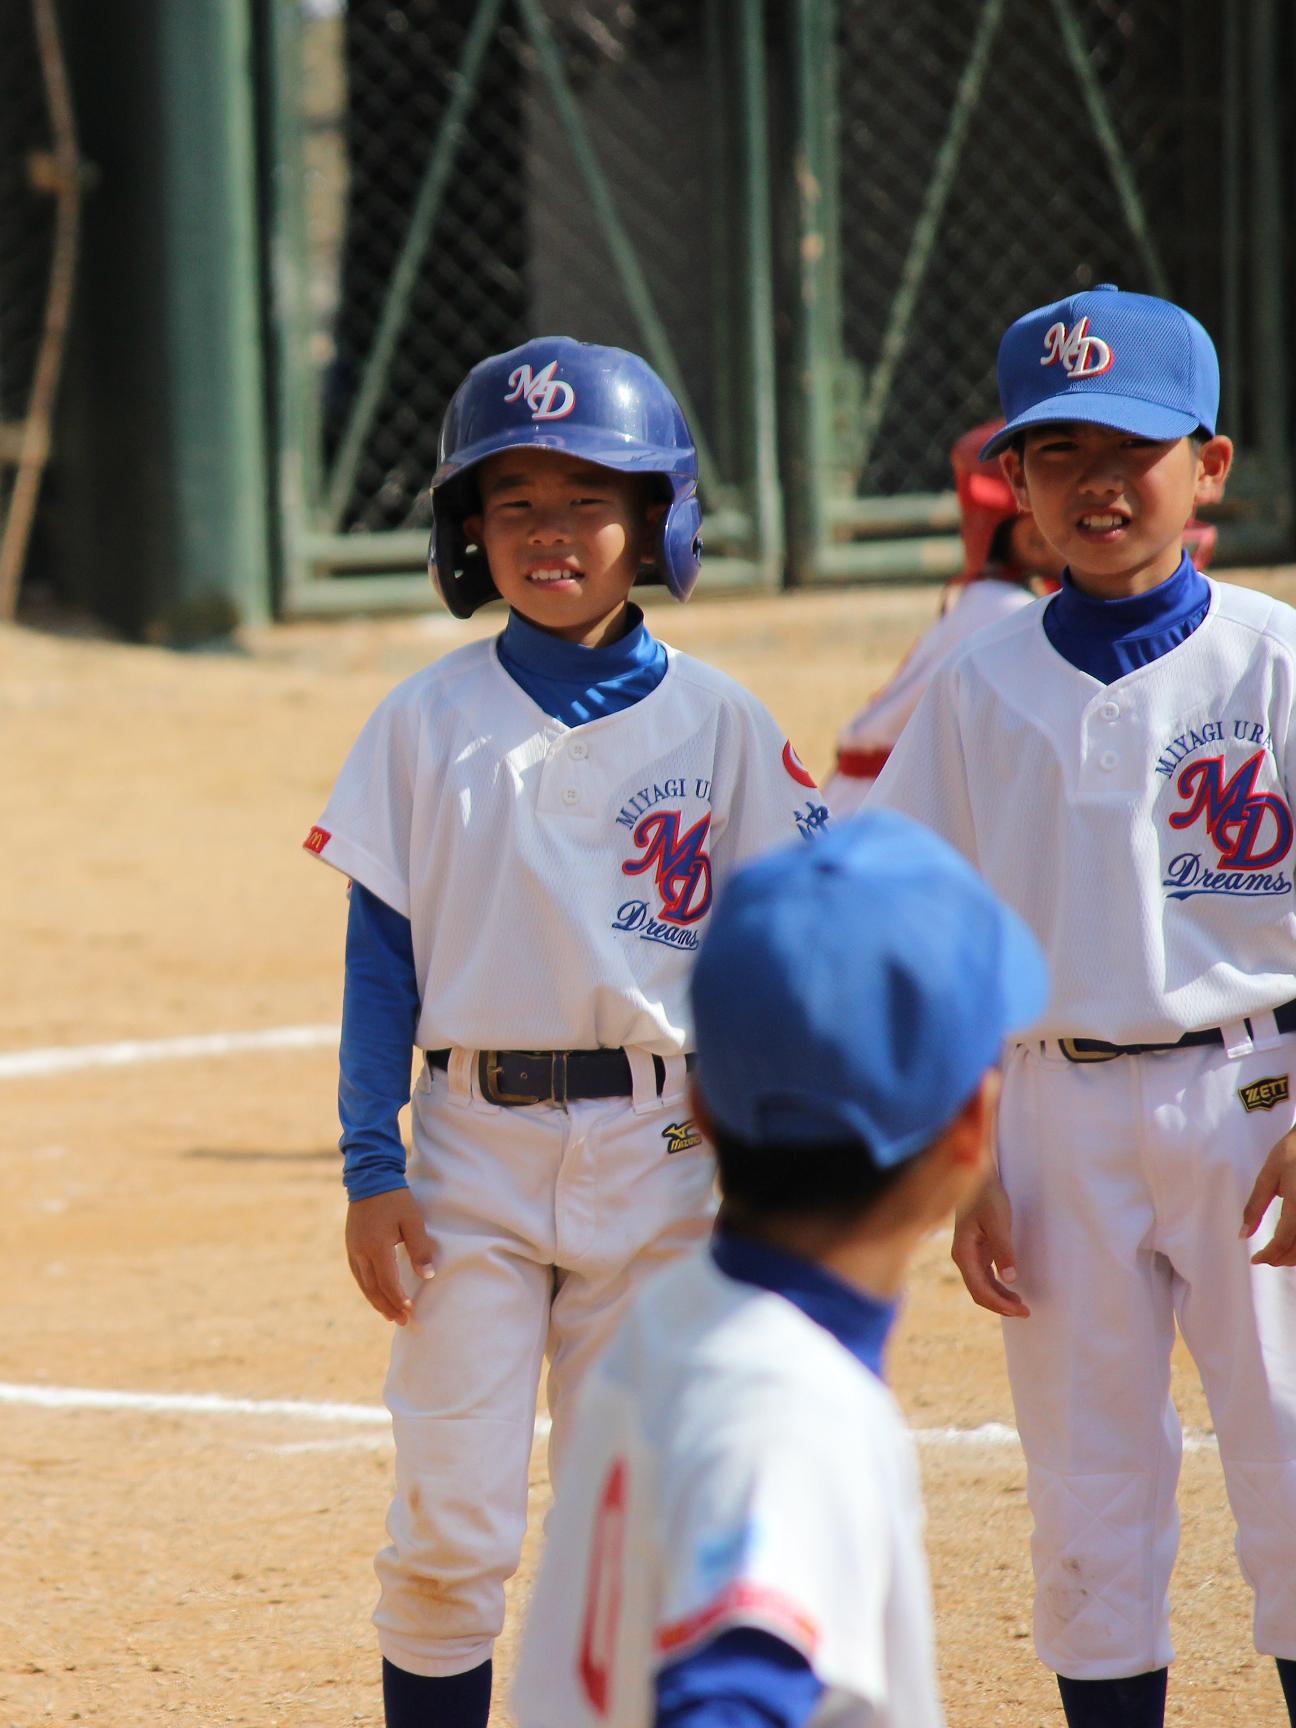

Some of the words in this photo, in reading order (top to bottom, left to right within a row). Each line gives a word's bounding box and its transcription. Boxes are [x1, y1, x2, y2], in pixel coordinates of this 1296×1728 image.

[1040, 315, 1115, 379] MD
[503, 360, 577, 420] MD
[1156, 720, 1225, 779] MIYAGI
[615, 778, 687, 831] MIYAGI
[1169, 749, 1294, 870] MD
[621, 809, 713, 926] MD
[1163, 852, 1293, 900] Dreams
[611, 899, 699, 950] Dreams
[1245, 1080, 1287, 1103] ZETT
